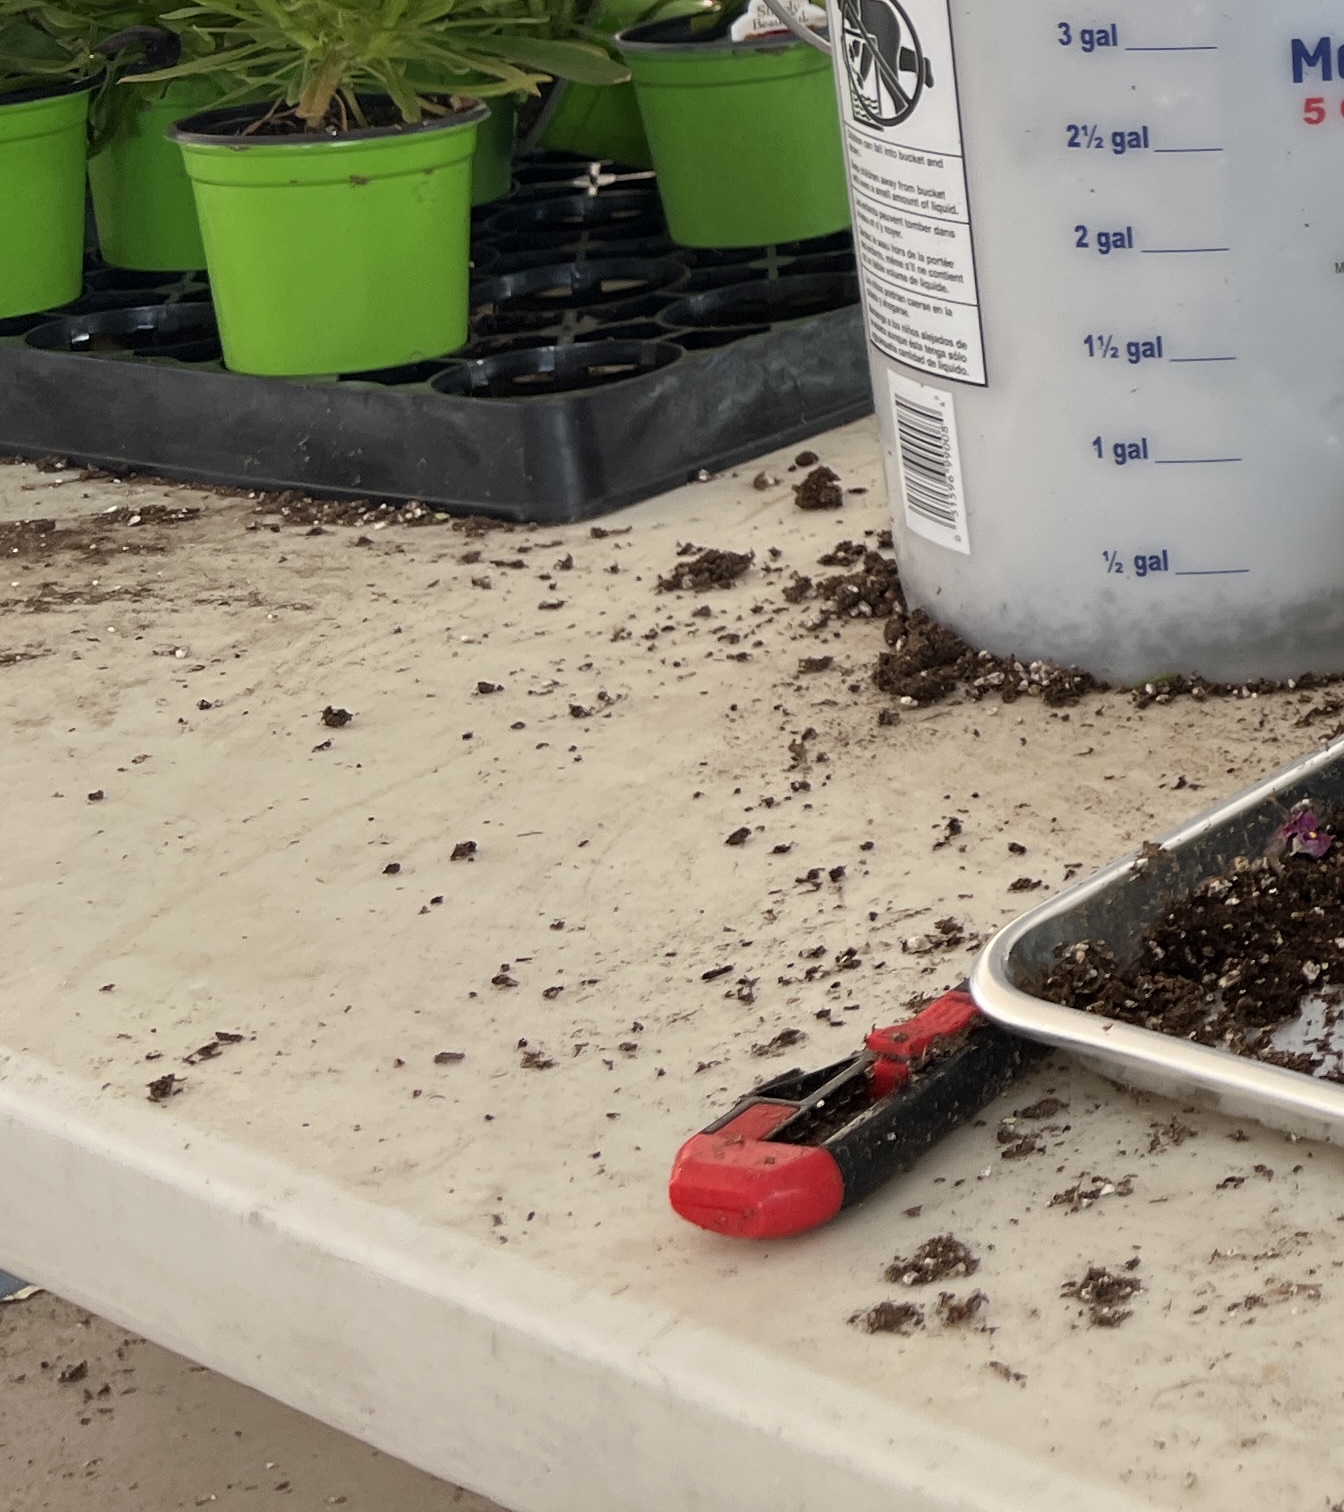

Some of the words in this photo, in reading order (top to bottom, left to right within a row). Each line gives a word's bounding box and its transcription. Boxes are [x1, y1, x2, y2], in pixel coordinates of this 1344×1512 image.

[1057, 22, 1072, 46] 3
[1080, 23, 1118, 52] gal
[1303, 97, 1326, 124] 5
[1111, 125, 1149, 155] gal
[898, 150, 925, 165] bucket
[927, 158, 944, 168] and
[893, 193, 919, 207] amount
[921, 200, 929, 209] of
[898, 181, 916, 193] from
[917, 185, 946, 200] bucket
[905, 219, 931, 233] tomber
[933, 227, 956, 238] dans
[1074, 224, 1089, 248] 2
[1097, 226, 1133, 255] gal
[928, 269, 964, 283] contient
[1126, 335, 1163, 364] gal
[1092, 436, 1103, 459] 1
[1113, 437, 1149, 465] gal
[954, 534, 962, 542] 0
[1134, 549, 1169, 577] gal
